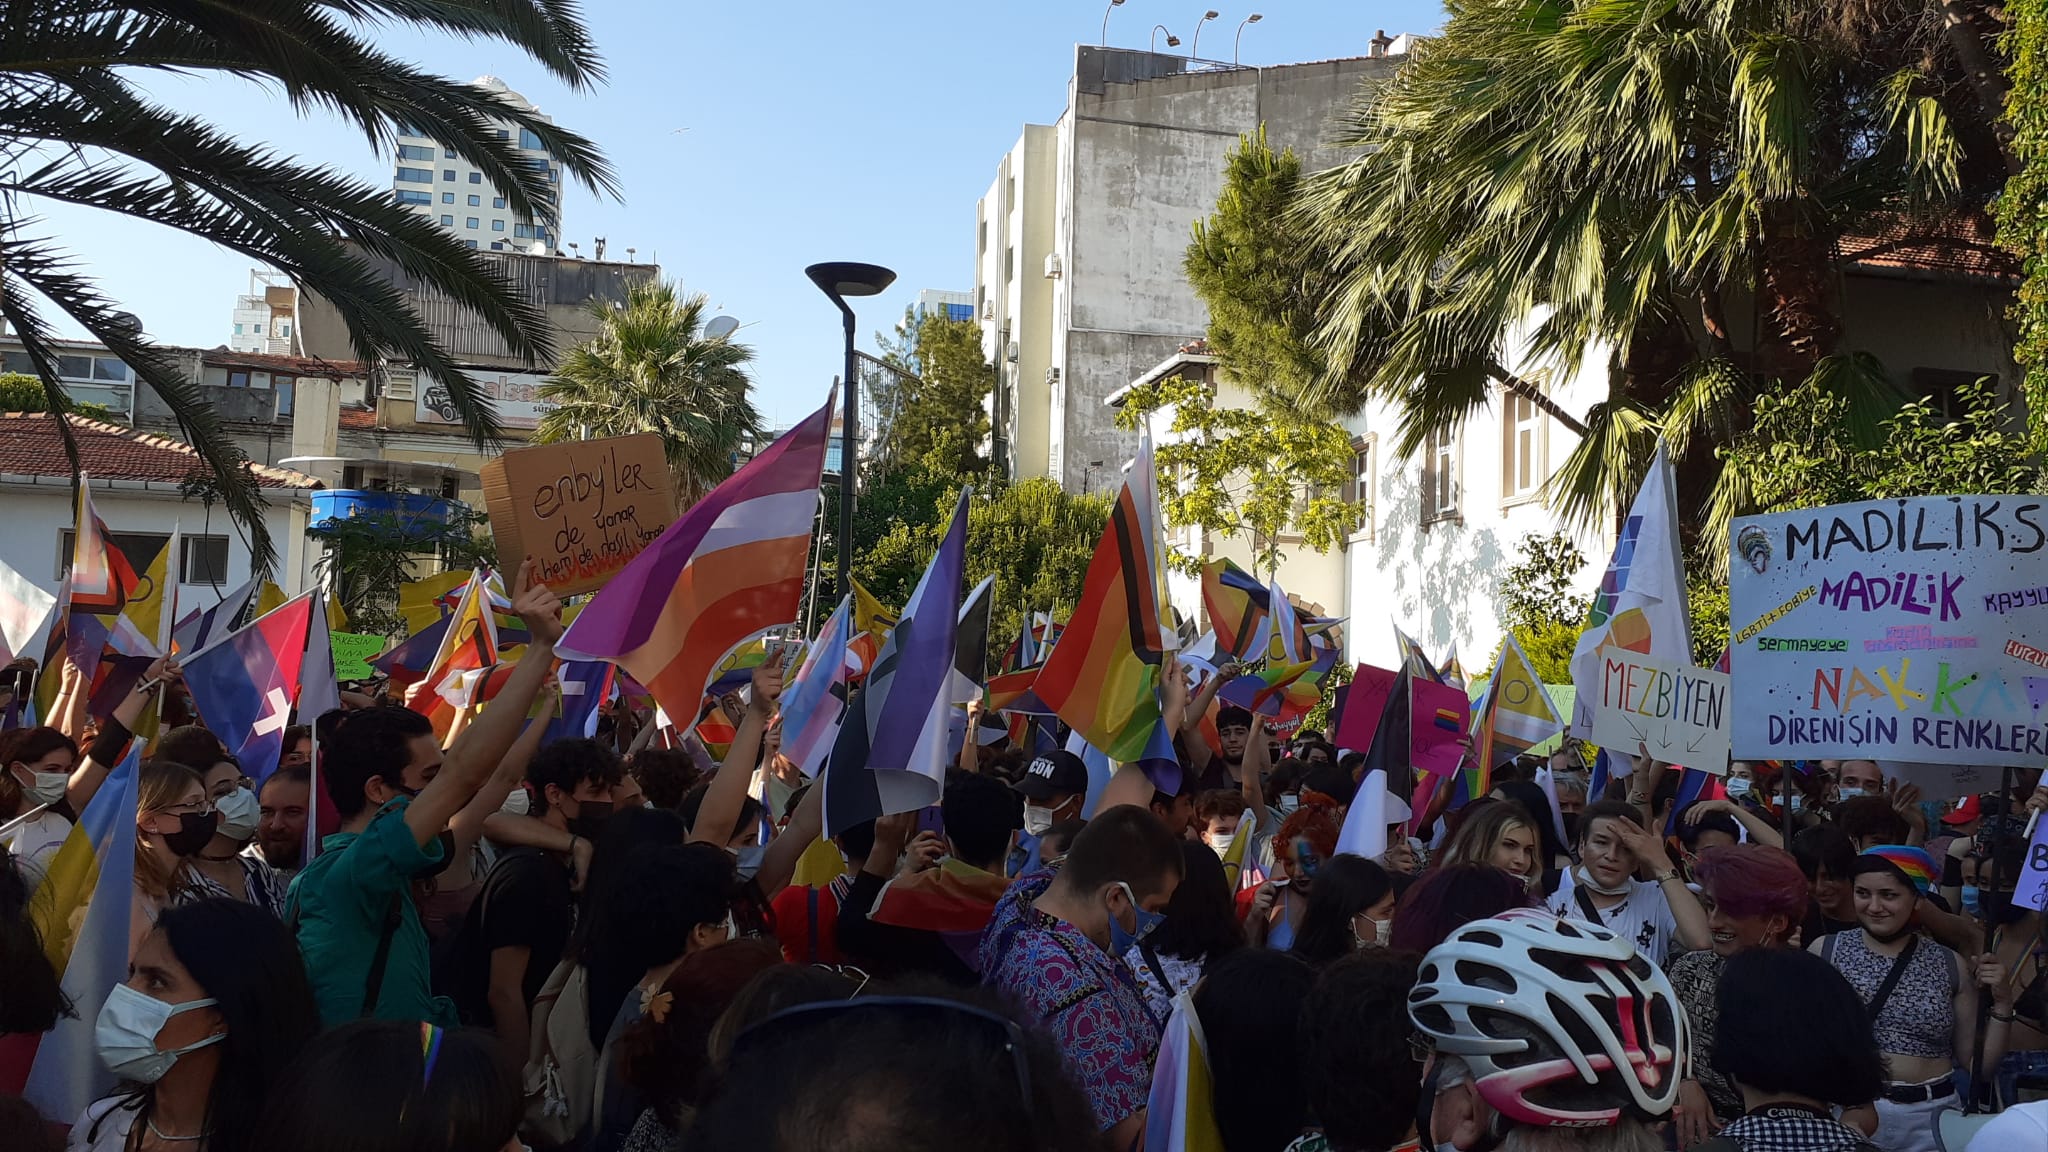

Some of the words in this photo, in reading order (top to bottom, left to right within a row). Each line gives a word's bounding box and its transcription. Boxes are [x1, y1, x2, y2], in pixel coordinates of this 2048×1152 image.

[555, 515, 585, 553] de
[541, 558, 573, 580] hem
[578, 543, 594, 565] de
[1819, 571, 1965, 622] MADİLİK
[1604, 658, 1725, 730] MEZBİYEN
[1768, 709, 1898, 748] DİRENİŞİN
[1550, 1119, 1609, 1128] LAZER
[1767, 1107, 1814, 1119] Canon
